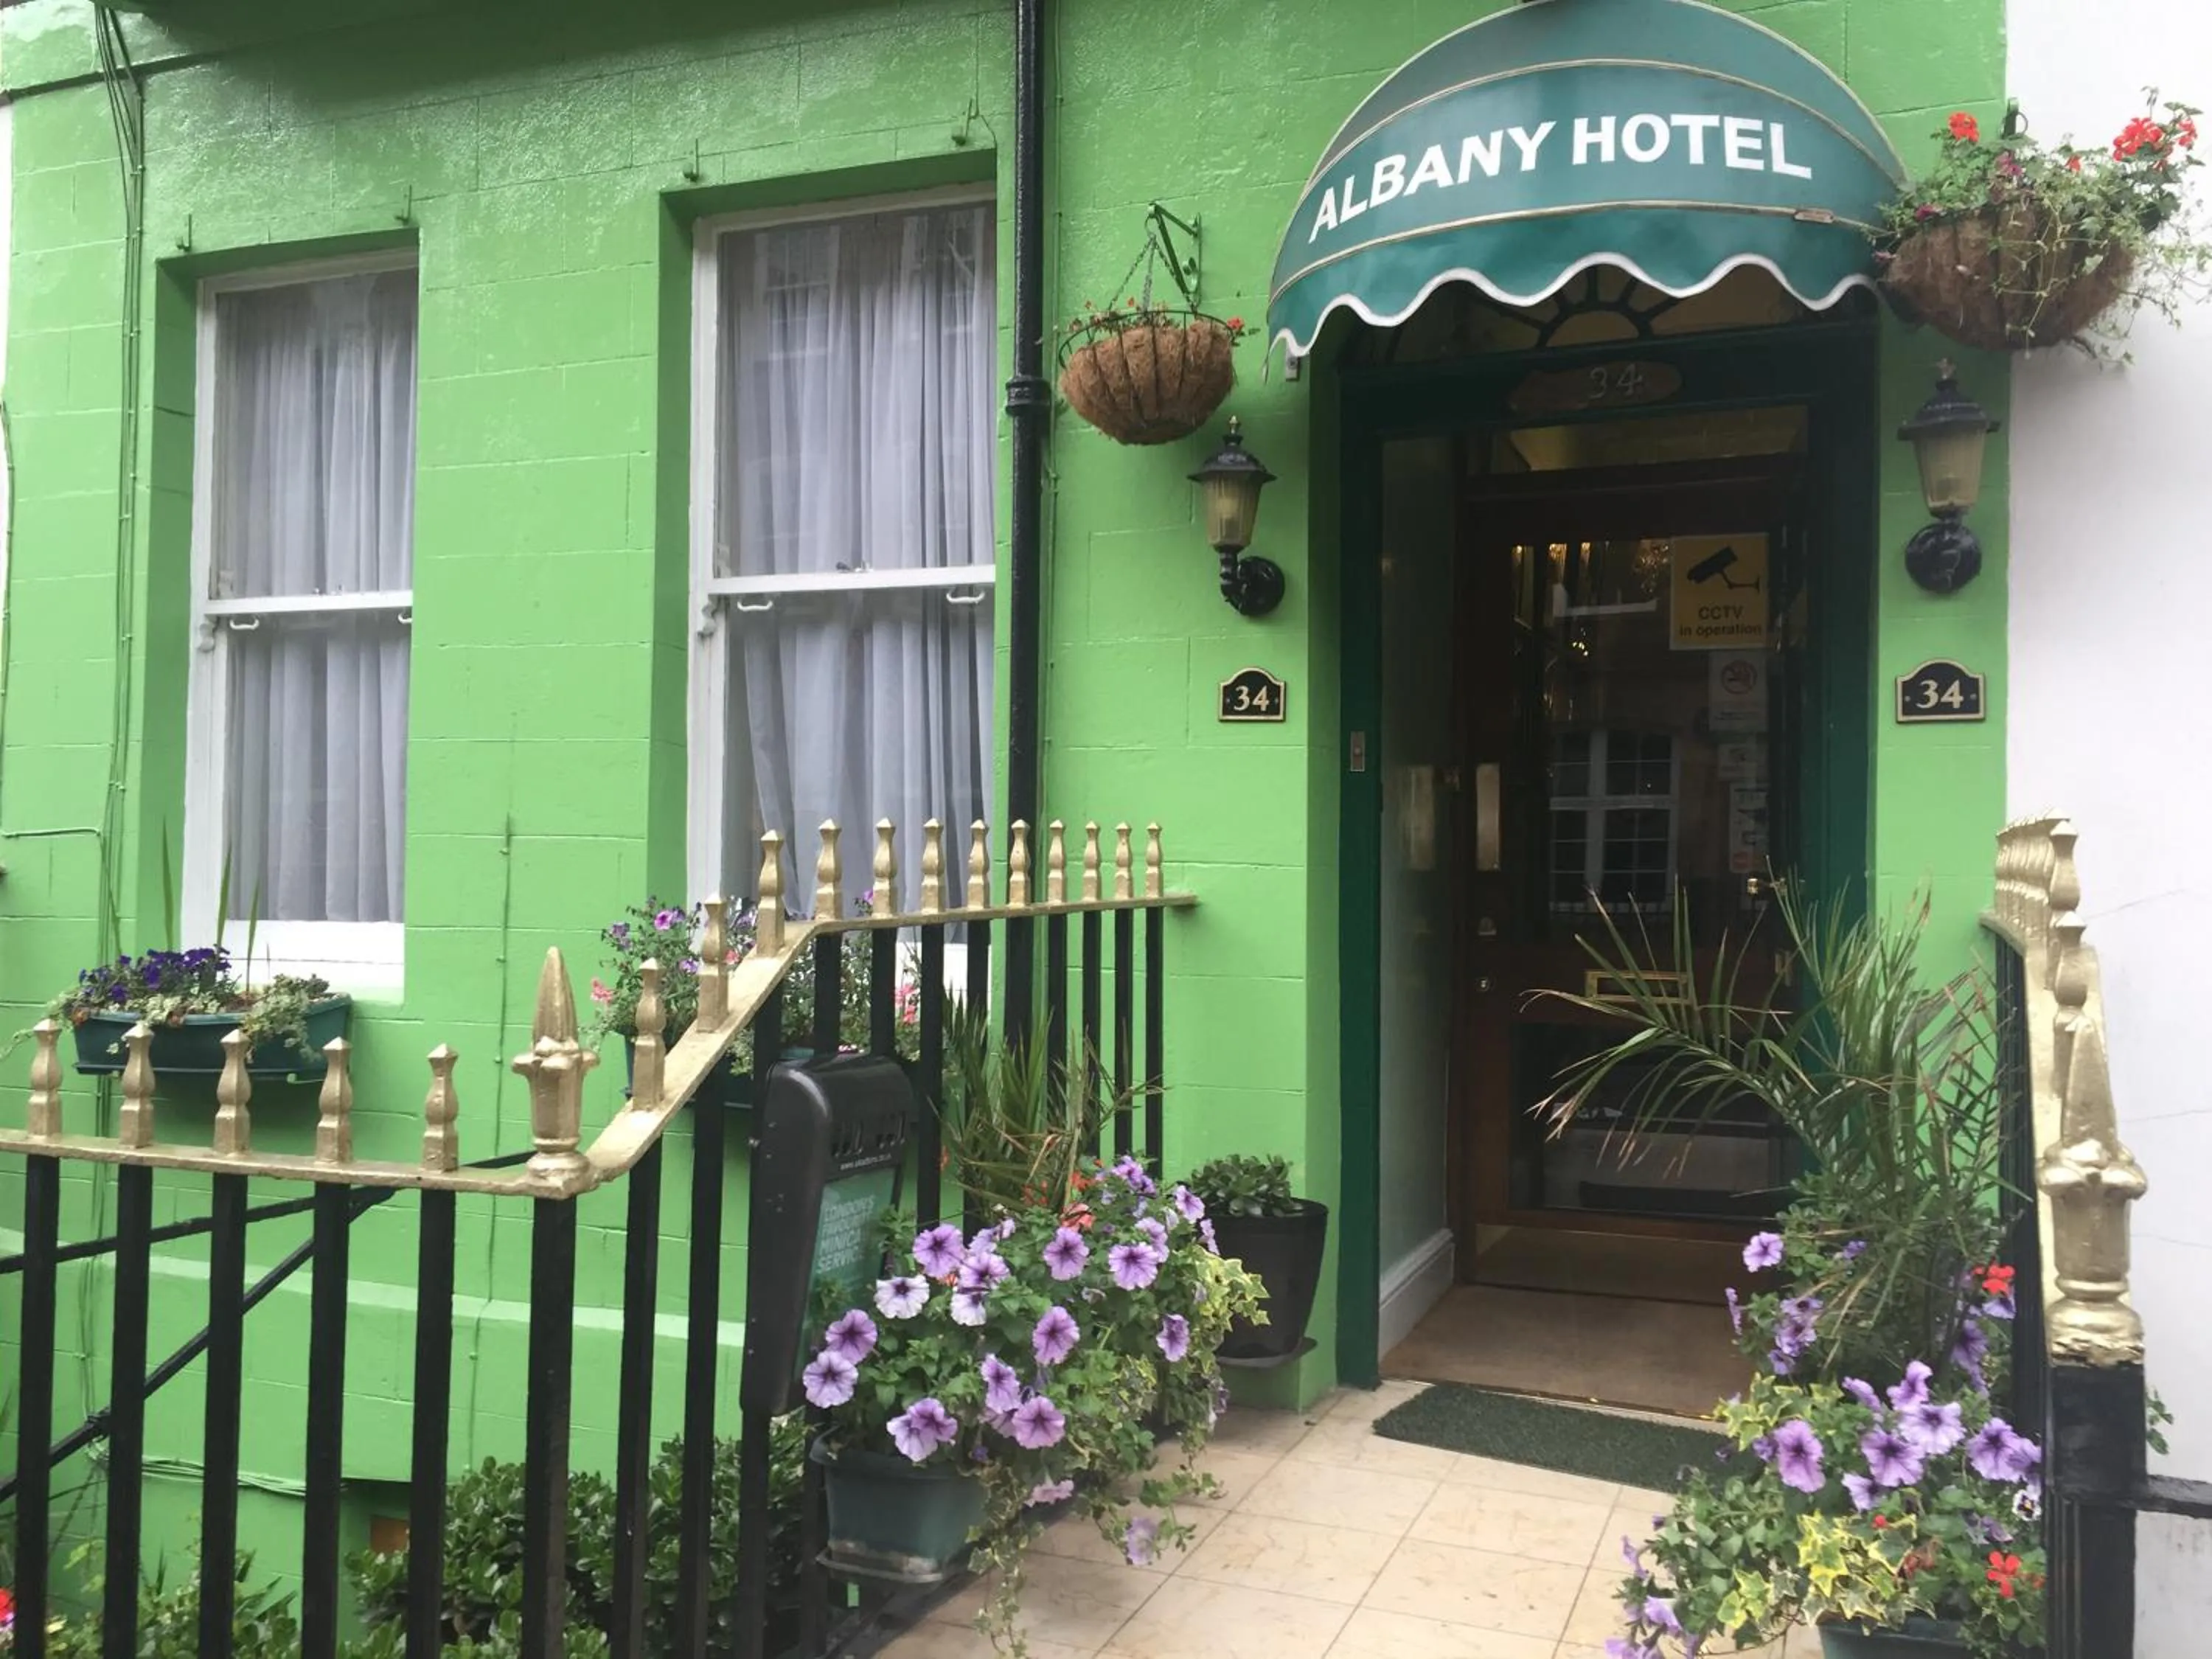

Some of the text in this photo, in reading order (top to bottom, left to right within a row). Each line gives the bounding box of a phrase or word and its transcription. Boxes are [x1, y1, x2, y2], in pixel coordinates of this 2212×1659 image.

[1309, 114, 1812, 243] ALBANY HOTEL
[1588, 363, 1643, 399] 34
[1698, 605, 1744, 620] CCTV
[1696, 624, 1761, 639] operation
[1234, 685, 1270, 712] 34
[1916, 679, 1964, 709] 34
[818, 1227, 864, 1256] MINICA
